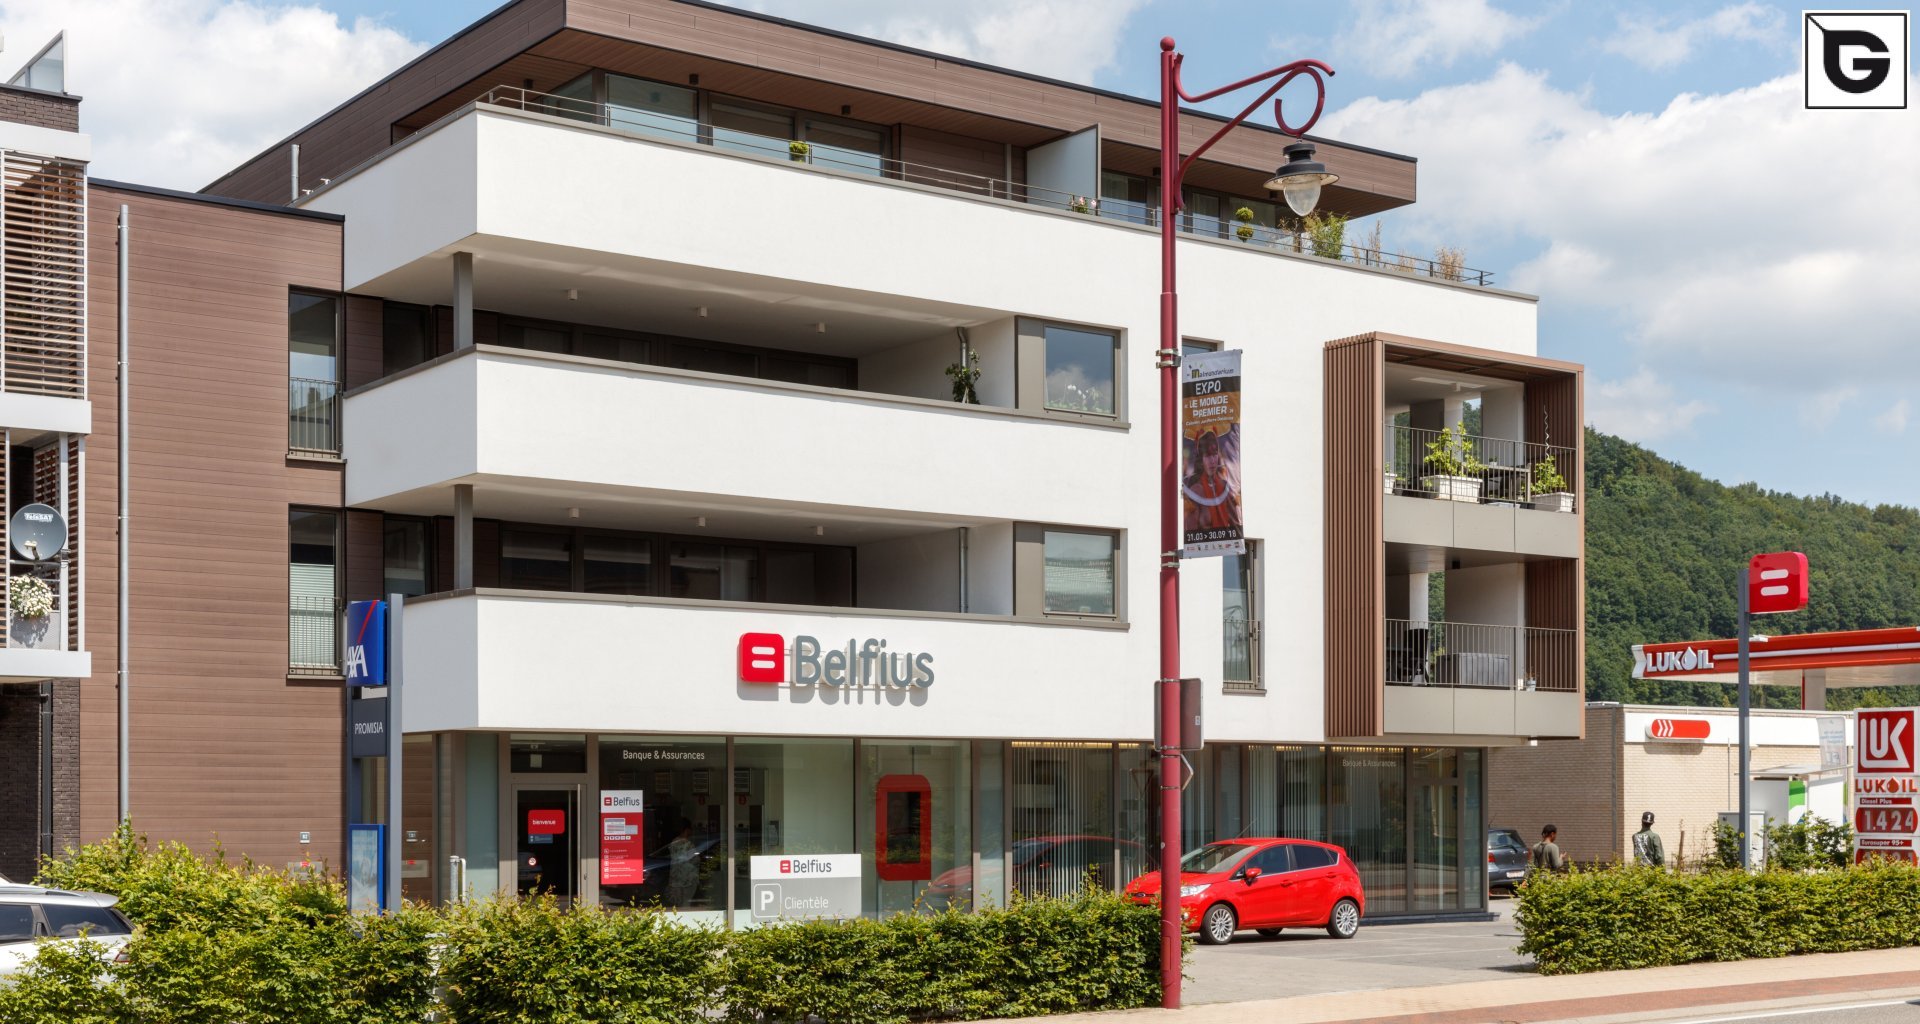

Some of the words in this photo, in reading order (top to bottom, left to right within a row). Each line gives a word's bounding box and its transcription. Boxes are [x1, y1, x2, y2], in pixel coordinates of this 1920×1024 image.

[1195, 380, 1221, 395] EXPO
[1190, 399, 1198, 408] LE
[1199, 395, 1229, 408] MONDE
[1192, 405, 1228, 418] PREMIER
[347, 645, 369, 679] AXA
[795, 635, 935, 688] Belfius
[1646, 646, 1714, 673] LUKOIL
[354, 721, 384, 734] PROMISIA
[623, 749, 652, 762] Banque
[653, 750, 660, 760] &
[661, 750, 705, 760] Assurances
[1855, 776, 1918, 793] LUKOIL
[613, 796, 640, 806] Belfius
[1864, 810, 1914, 831] 1.424
[793, 859, 832, 873] Belfius
[760, 890, 775, 911] P
[784, 896, 829, 910] Clientèle
